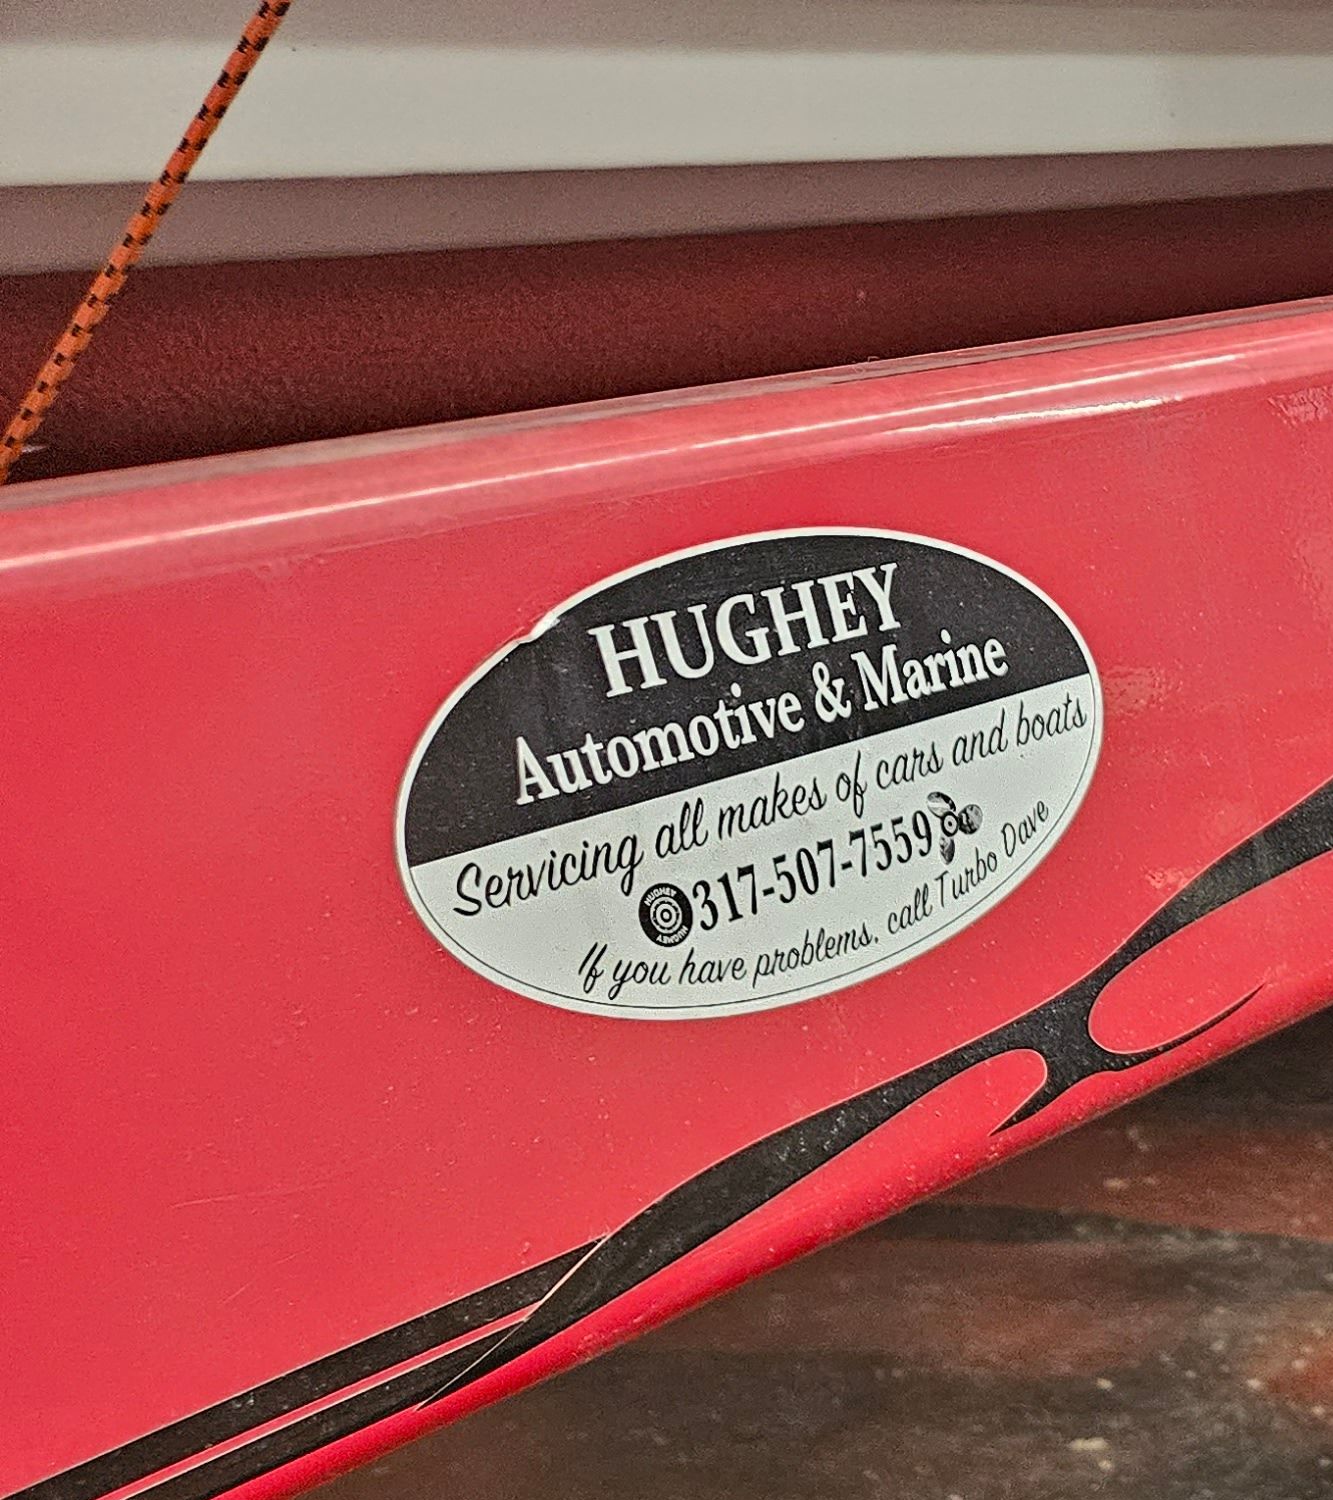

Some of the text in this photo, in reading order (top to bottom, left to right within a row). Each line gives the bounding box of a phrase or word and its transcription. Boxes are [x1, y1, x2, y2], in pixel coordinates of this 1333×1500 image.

[516, 628, 1009, 806] Automotive & Marine
[587, 562, 901, 698] HUGHEY
[453, 692, 1087, 916] Servicing all makes of cars and boats
[692, 810, 933, 931] 317-507-7559
[578, 941, 608, 994] If
[612, 959, 671, 1000] you
[679, 947, 748, 985] have
[887, 883, 933, 935] call
[935, 846, 998, 908] Turbo
[1001, 800, 1049, 859] Dave
